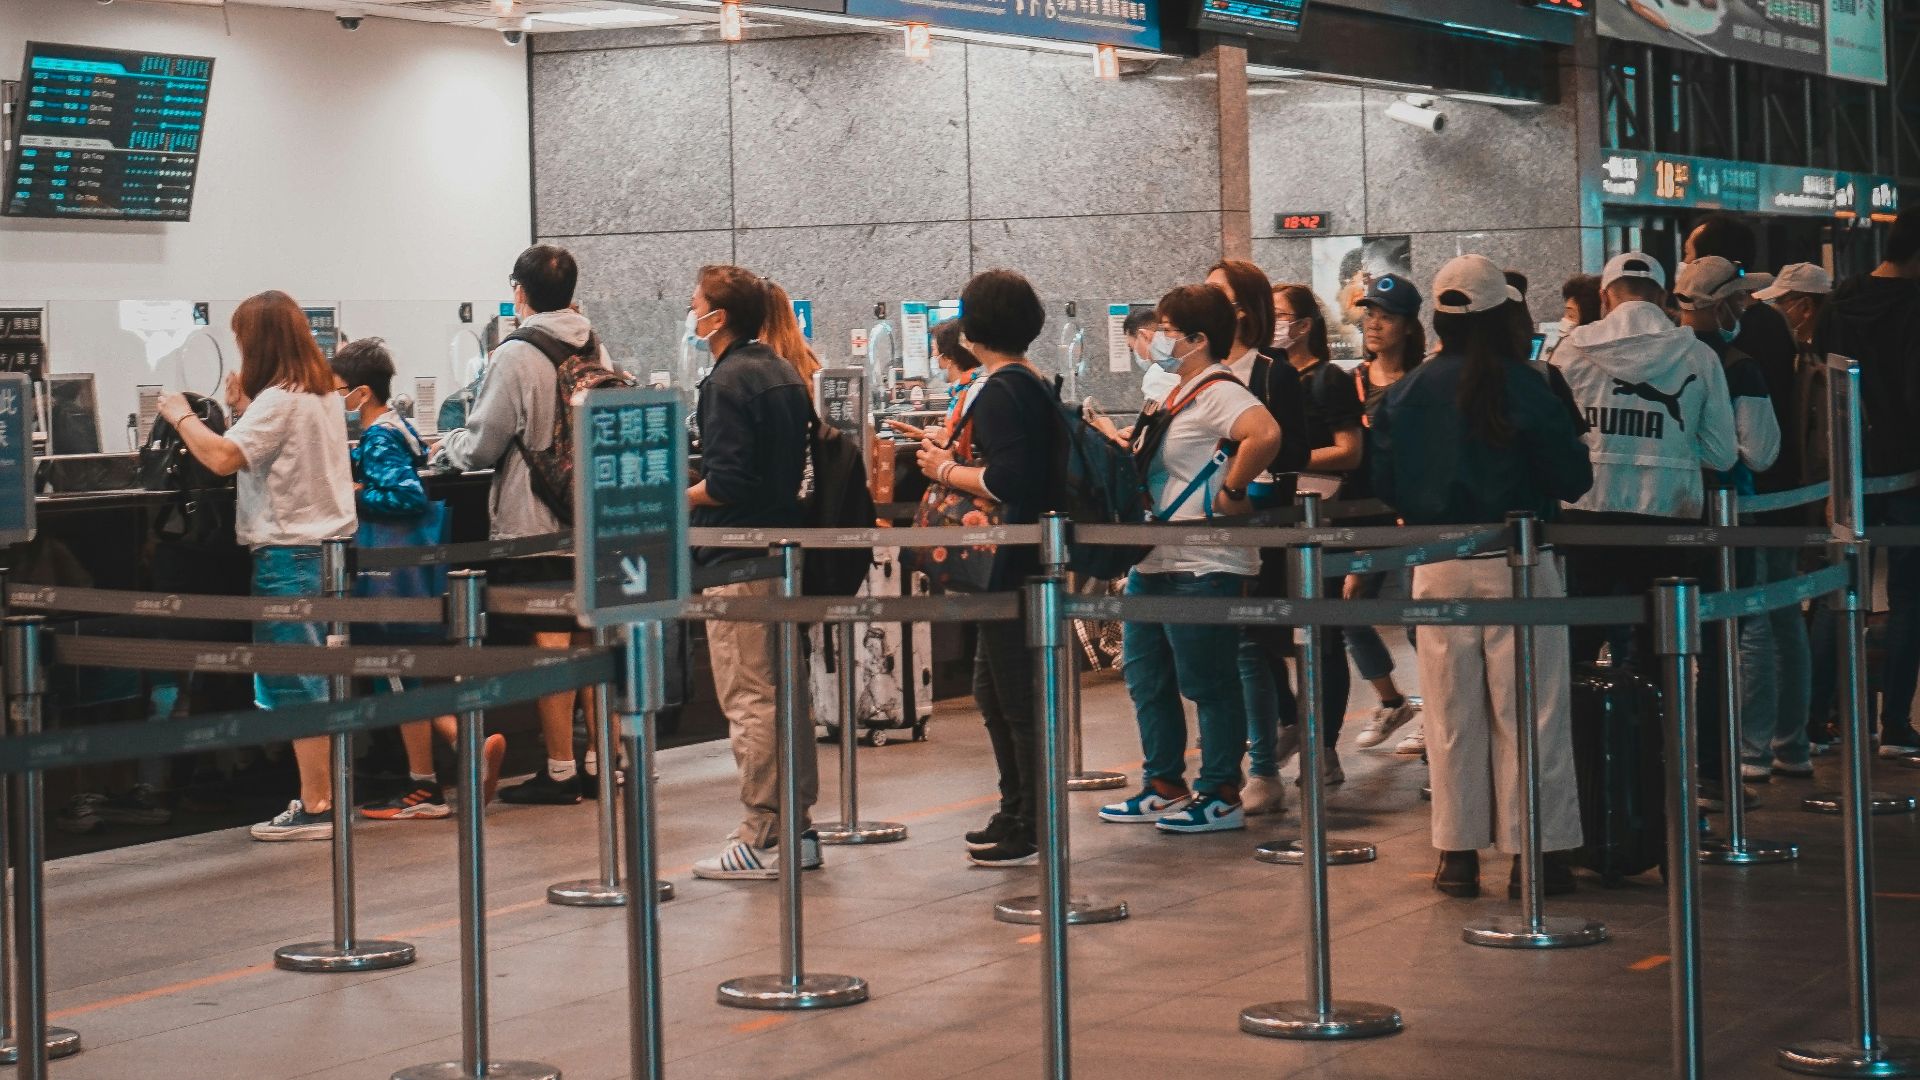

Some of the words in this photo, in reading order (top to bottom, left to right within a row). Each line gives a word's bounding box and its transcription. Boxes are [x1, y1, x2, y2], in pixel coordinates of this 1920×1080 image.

[911, 25, 930, 57] 2
[1283, 216, 1320, 230] 18:42
[592, 406, 669, 446] 定期票
[1584, 406, 1664, 440] PUMA
[594, 448, 670, 489] 回數票
